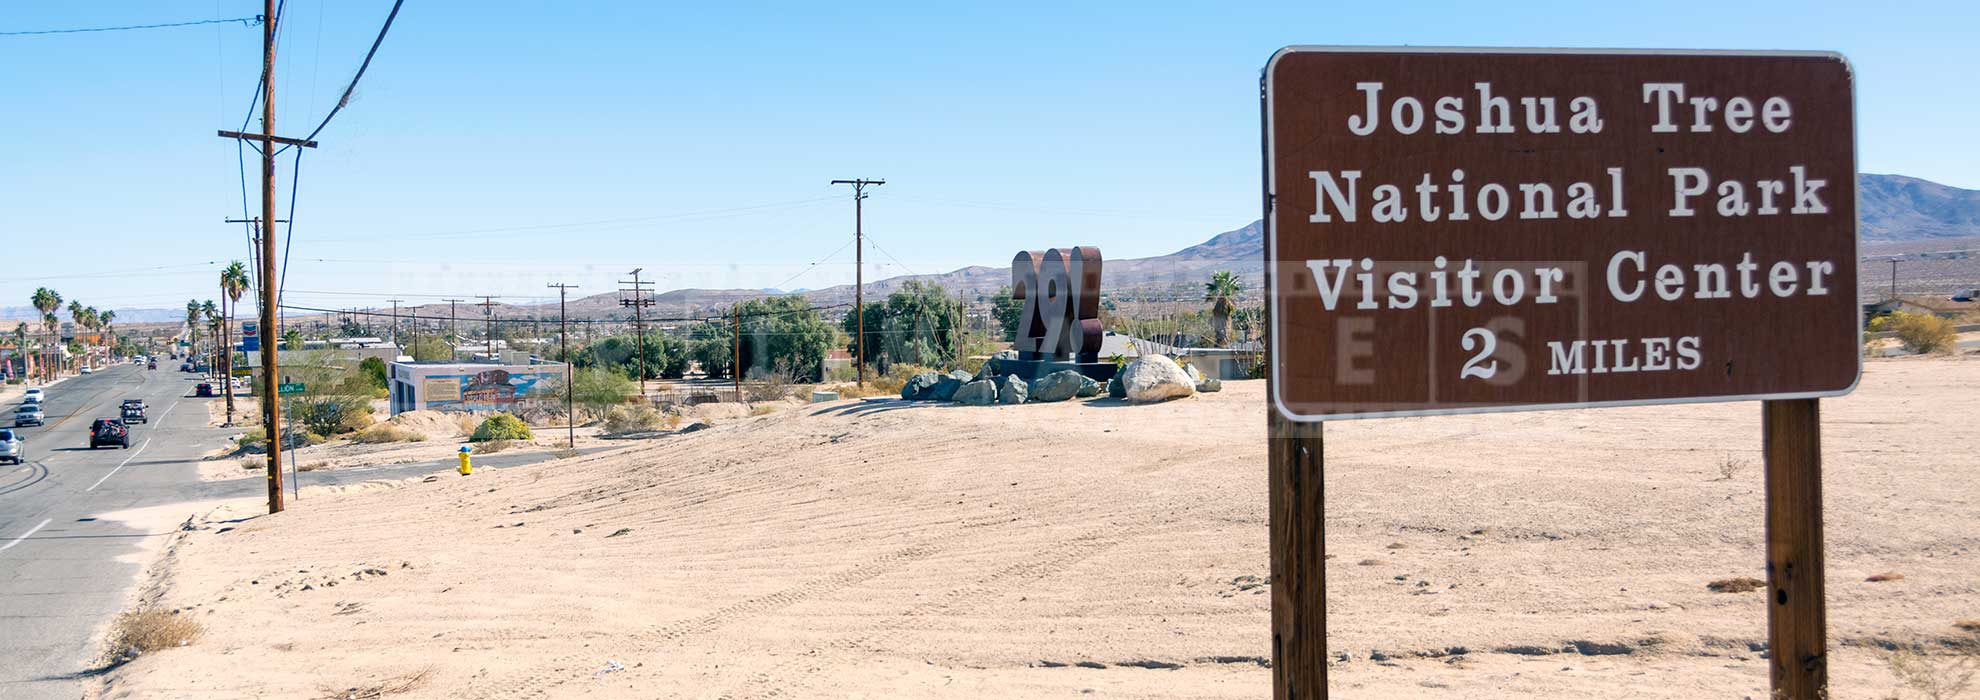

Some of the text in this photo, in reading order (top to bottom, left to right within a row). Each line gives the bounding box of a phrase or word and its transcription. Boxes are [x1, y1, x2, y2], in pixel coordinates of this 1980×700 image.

[1347, 82, 1793, 137] Joshua Tree
[1308, 165, 1828, 224] National Park
[1306, 249, 1834, 311] Visitor Center
[1460, 327, 1701, 380] 2 MILES
